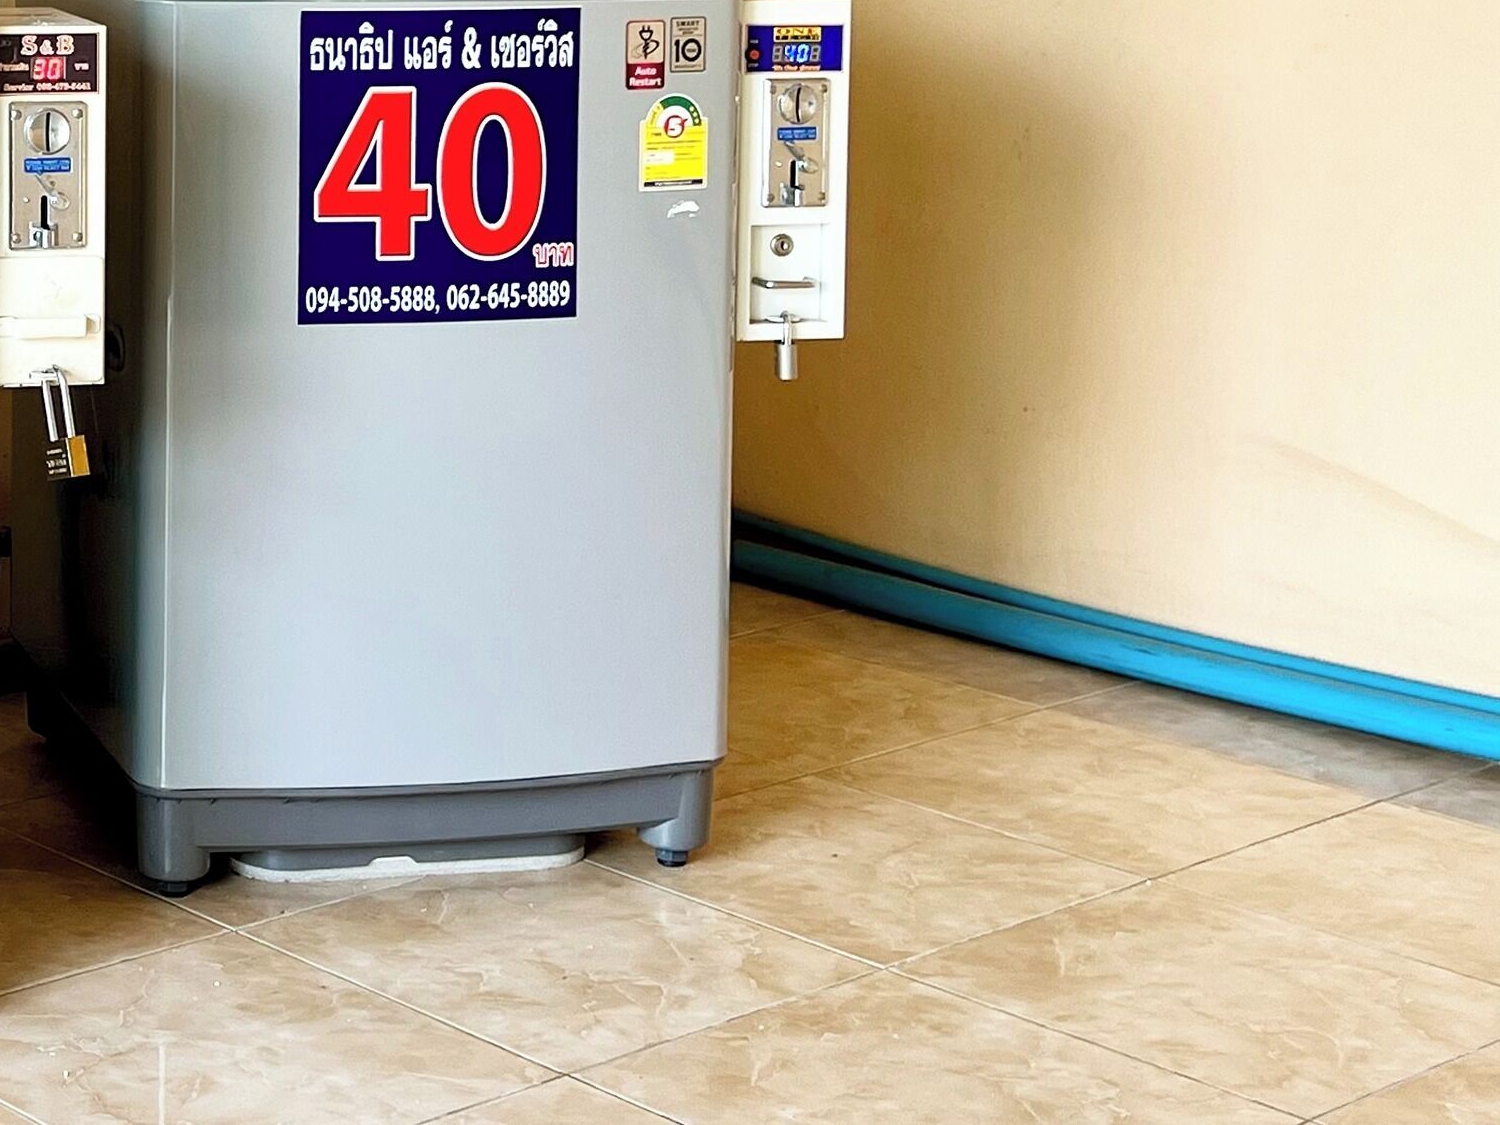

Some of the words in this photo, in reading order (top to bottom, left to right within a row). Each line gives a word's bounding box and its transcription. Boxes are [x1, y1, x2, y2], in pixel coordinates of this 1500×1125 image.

[309, 21, 393, 71] ธนาธิป
[404, 19, 453, 70] แอร์
[461, 27, 481, 69] &
[673, 38, 702, 63] 10
[784, 43, 810, 64] 40
[32, 58, 63, 81] 30
[629, 77, 662, 87] Restart
[634, 66, 657, 76] Auto
[313, 81, 547, 262] 40
[531, 241, 574, 268] บาท
[305, 285, 440, 314] 094-508-5888,
[446, 280, 571, 311] 062-645-8889
